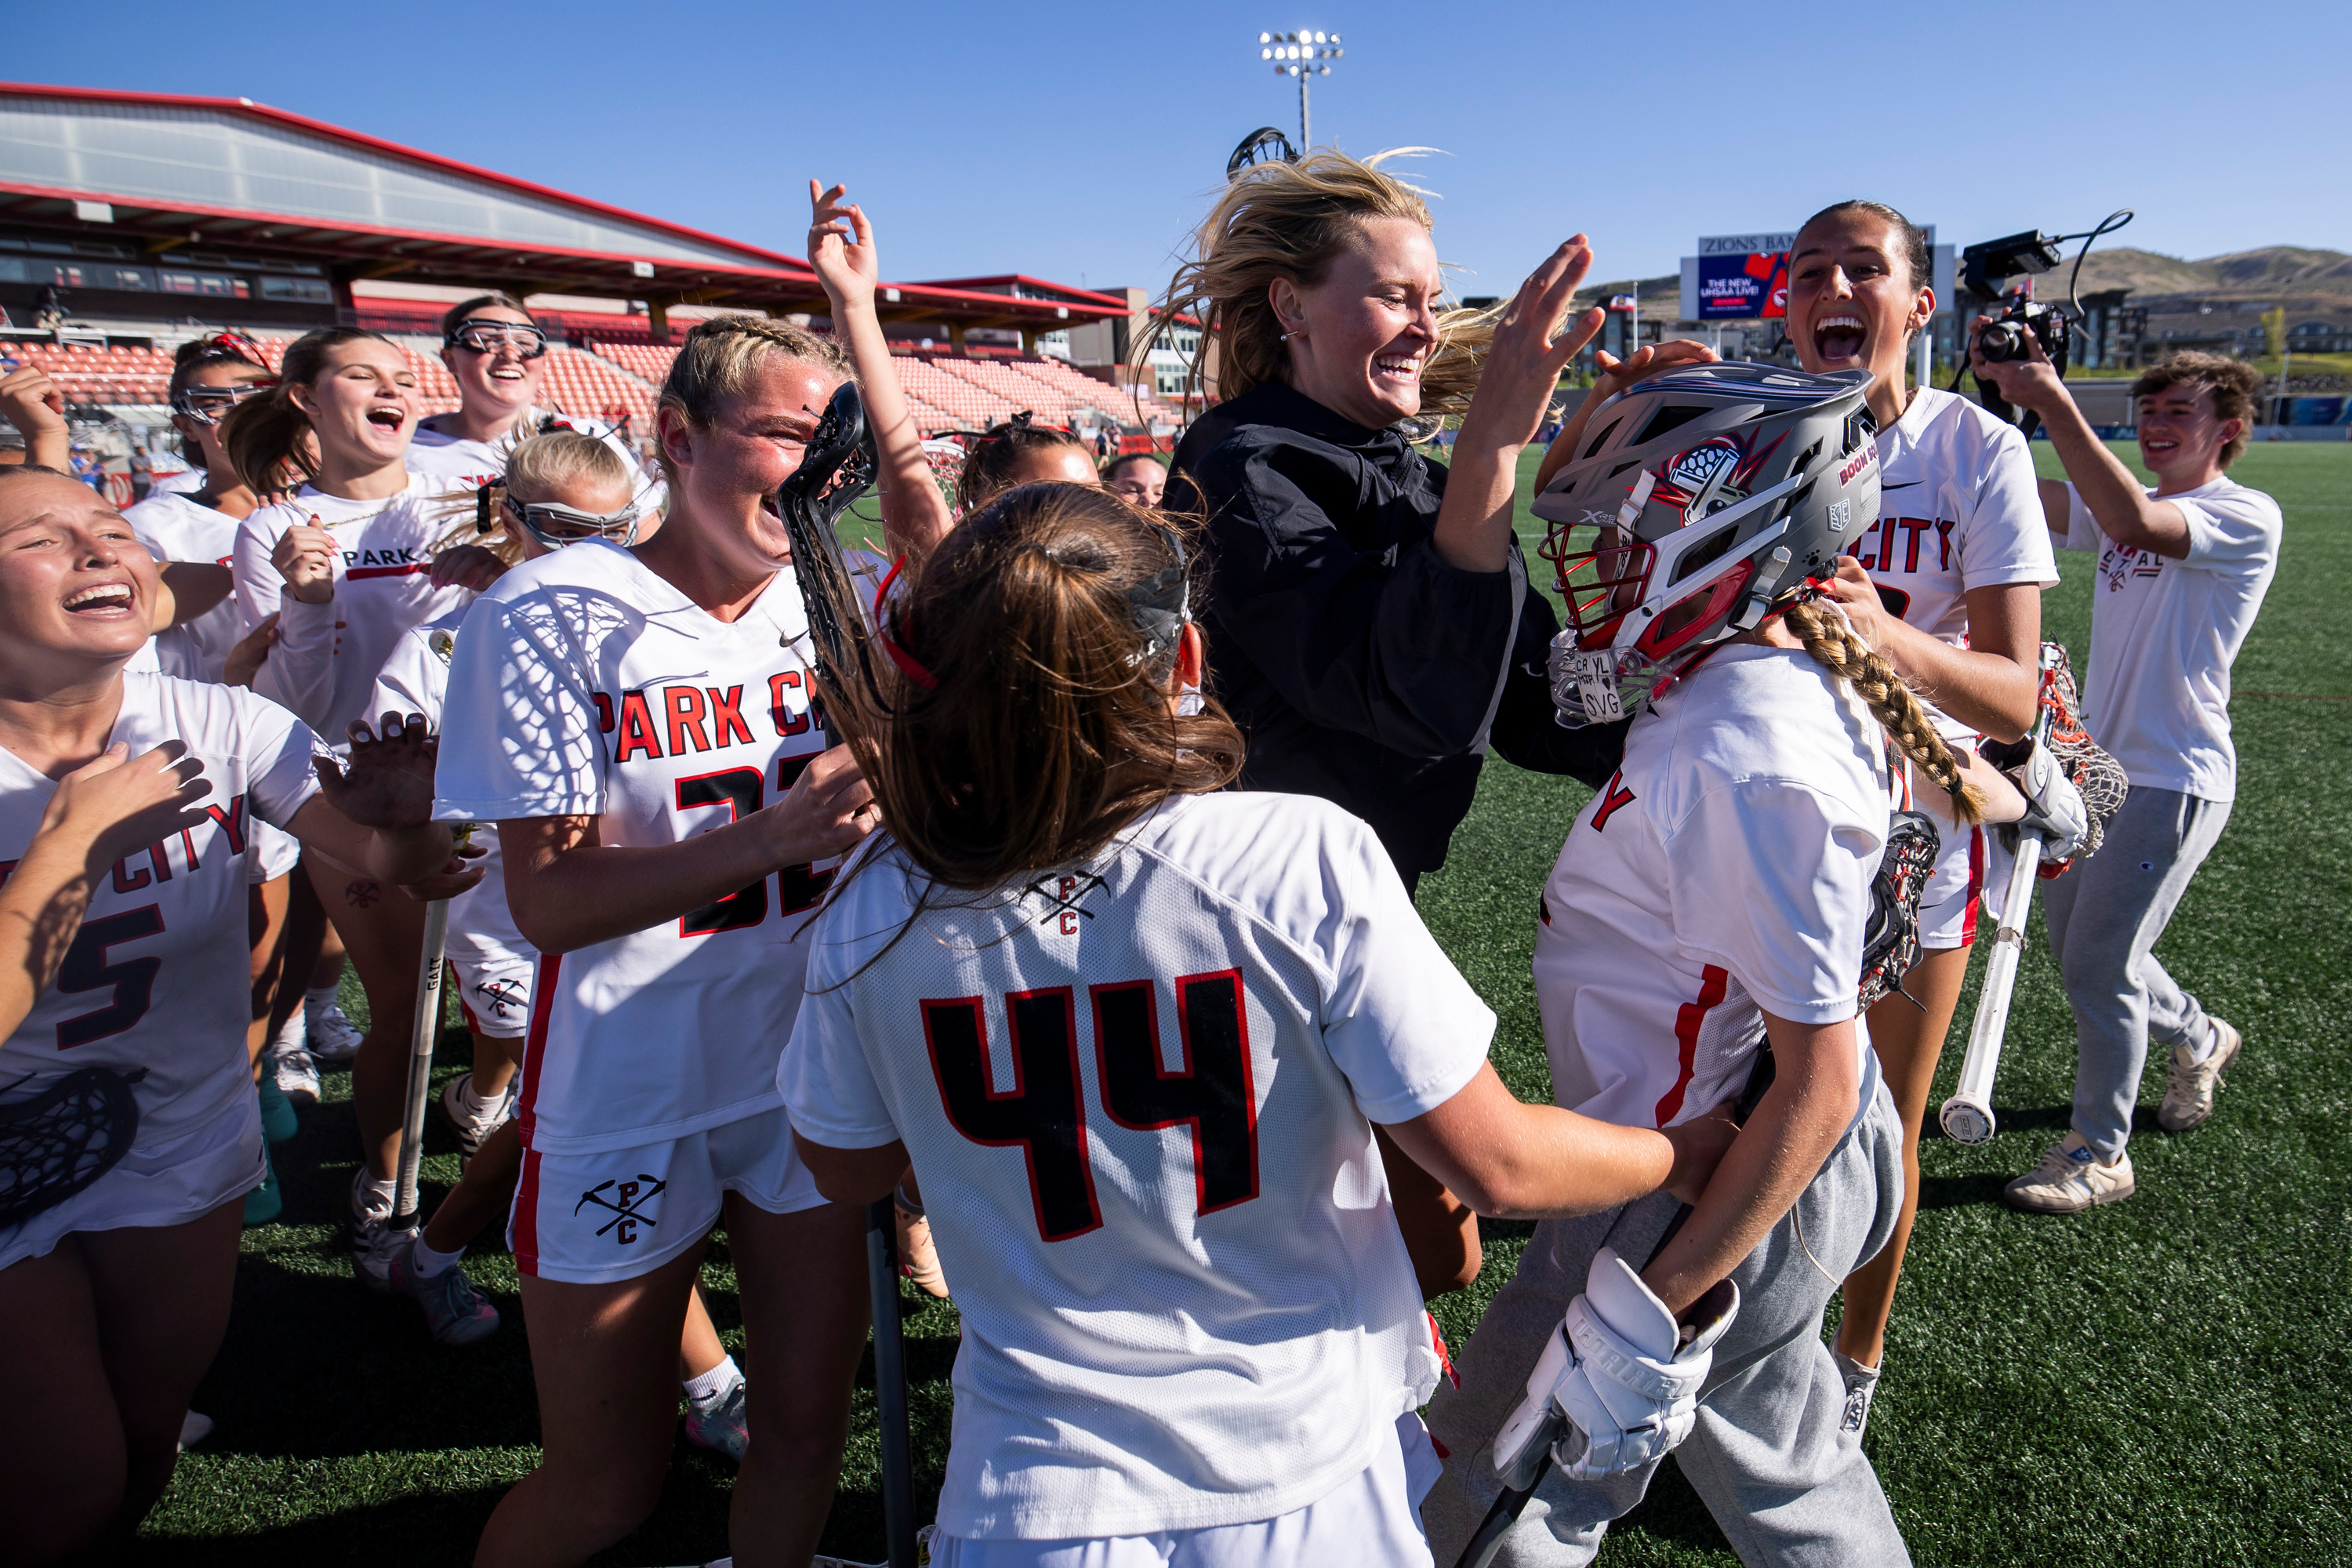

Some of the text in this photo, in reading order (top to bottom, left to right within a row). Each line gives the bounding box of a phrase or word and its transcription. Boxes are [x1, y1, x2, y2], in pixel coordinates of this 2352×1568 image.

[1705, 235, 1795, 252] ZIONS BAN
[1700, 286, 1759, 297] UHSAA LIVE!
[1708, 278, 1751, 289] THE NEW
[1839, 451, 1868, 487] BOOM
[343, 547, 419, 567] PARK
[1846, 517, 1955, 574] CITY
[1585, 693, 1619, 717] SVG
[111, 793, 246, 894] CITY
[426, 957, 441, 991] GAIT
[919, 967, 1260, 1243] 44
